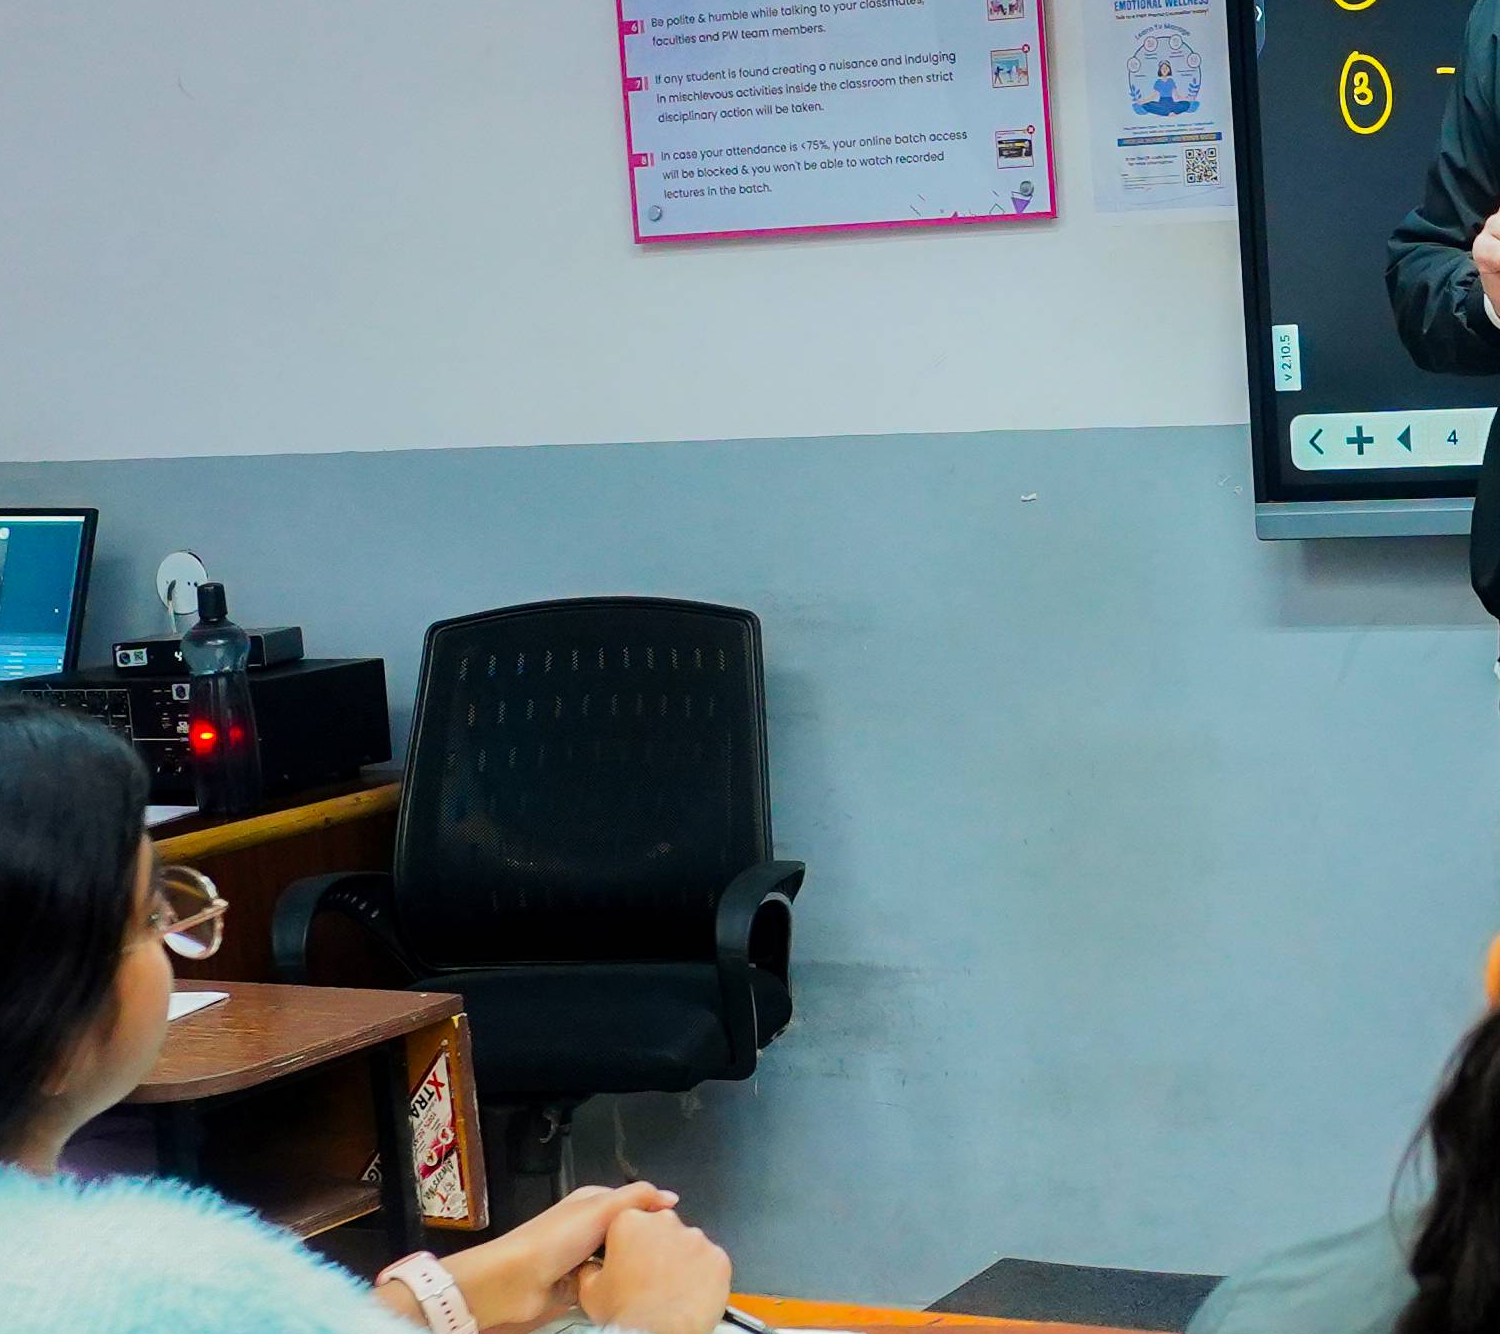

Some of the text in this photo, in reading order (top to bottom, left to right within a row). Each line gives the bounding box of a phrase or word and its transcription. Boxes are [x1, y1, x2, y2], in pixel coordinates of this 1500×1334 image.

[1280, 333, 1292, 372] 2.10.5
[1446, 429, 1459, 446] 4
[410, 1070, 445, 1118] XTRA
